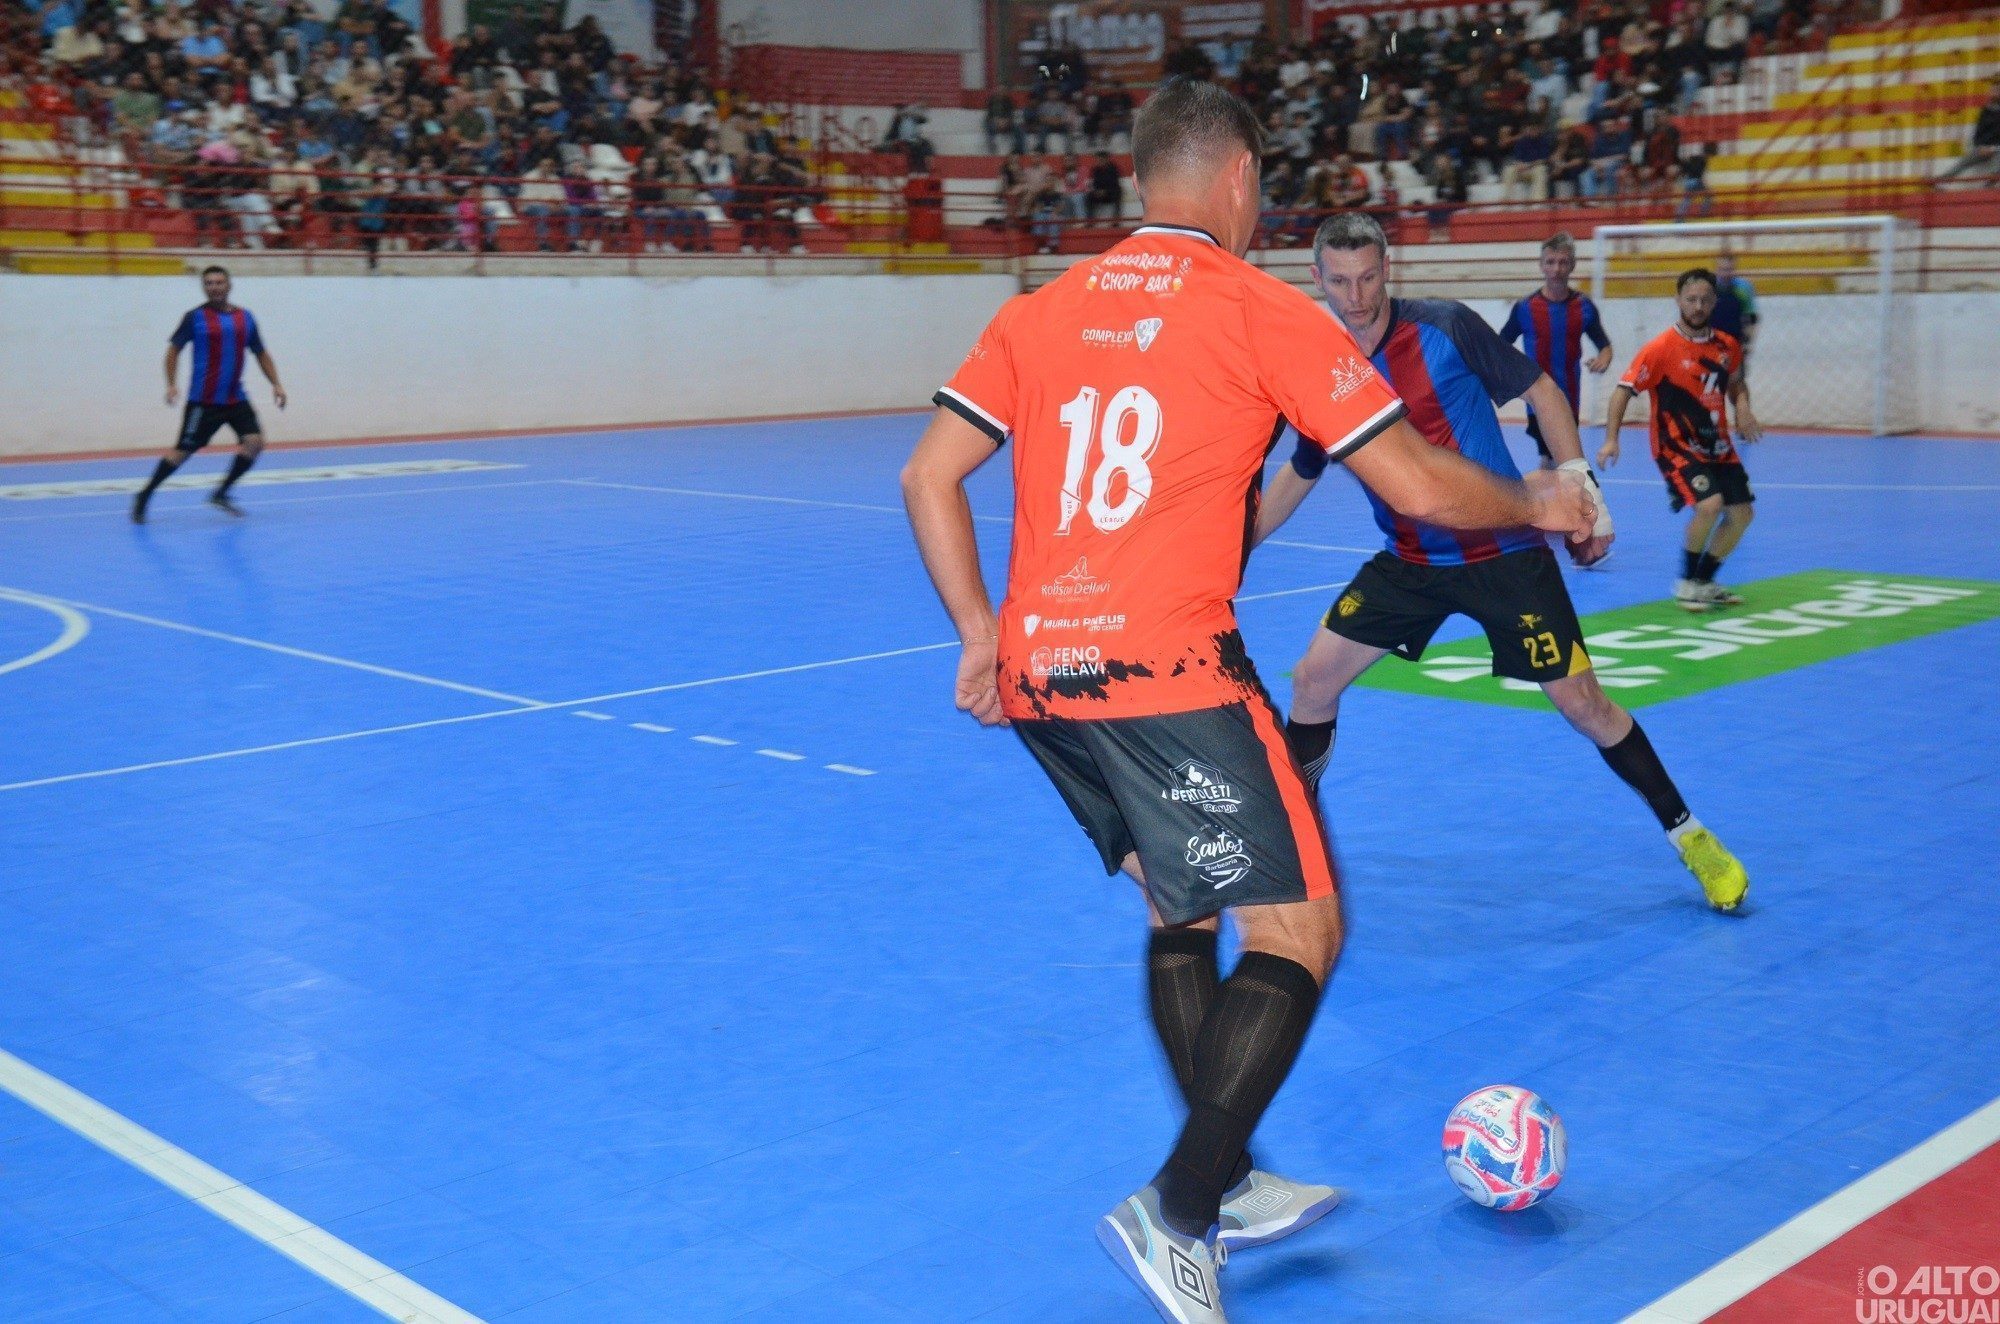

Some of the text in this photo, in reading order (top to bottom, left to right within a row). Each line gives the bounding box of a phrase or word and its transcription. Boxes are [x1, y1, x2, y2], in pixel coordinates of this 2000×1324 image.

[1101, 272, 1144, 291] CHOPP
[1082, 328, 1135, 343] COMPLEXO
[1054, 385, 1163, 535] 18
[1043, 614, 1126, 629] MURILO PNEUS
[1584, 580, 1983, 660] Sicredi
[1053, 645, 1100, 662] FENO
[1522, 631, 1562, 669] 23
[1053, 662, 1106, 676] DELAVI
[1171, 785, 1231, 802] BERTOLETI
[1184, 831, 1243, 865] Santos
